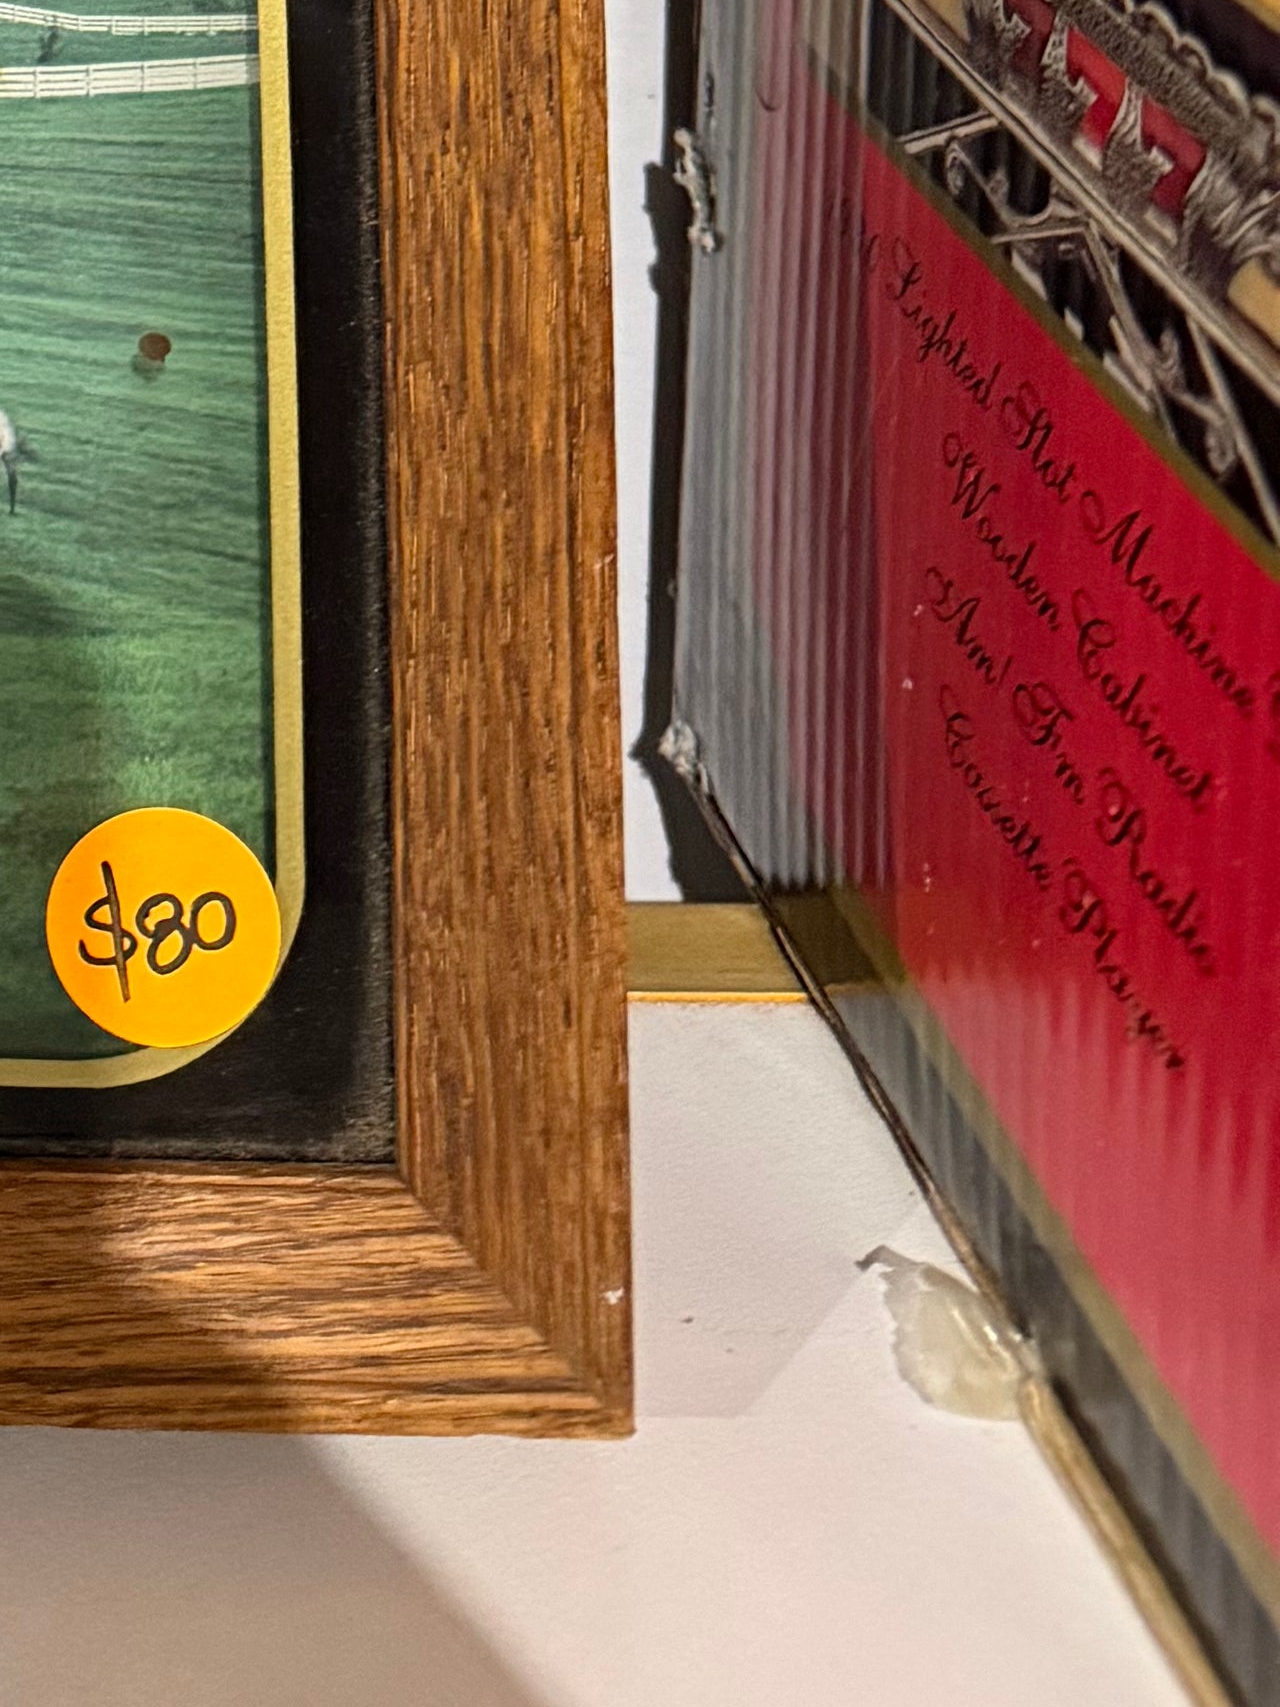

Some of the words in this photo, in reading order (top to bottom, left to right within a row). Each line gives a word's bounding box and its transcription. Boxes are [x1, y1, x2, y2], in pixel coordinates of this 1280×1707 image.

[887, 237, 1001, 412] Lighted
[1080, 490, 1254, 716] Machine
[78, 861, 236, 1003] $80
